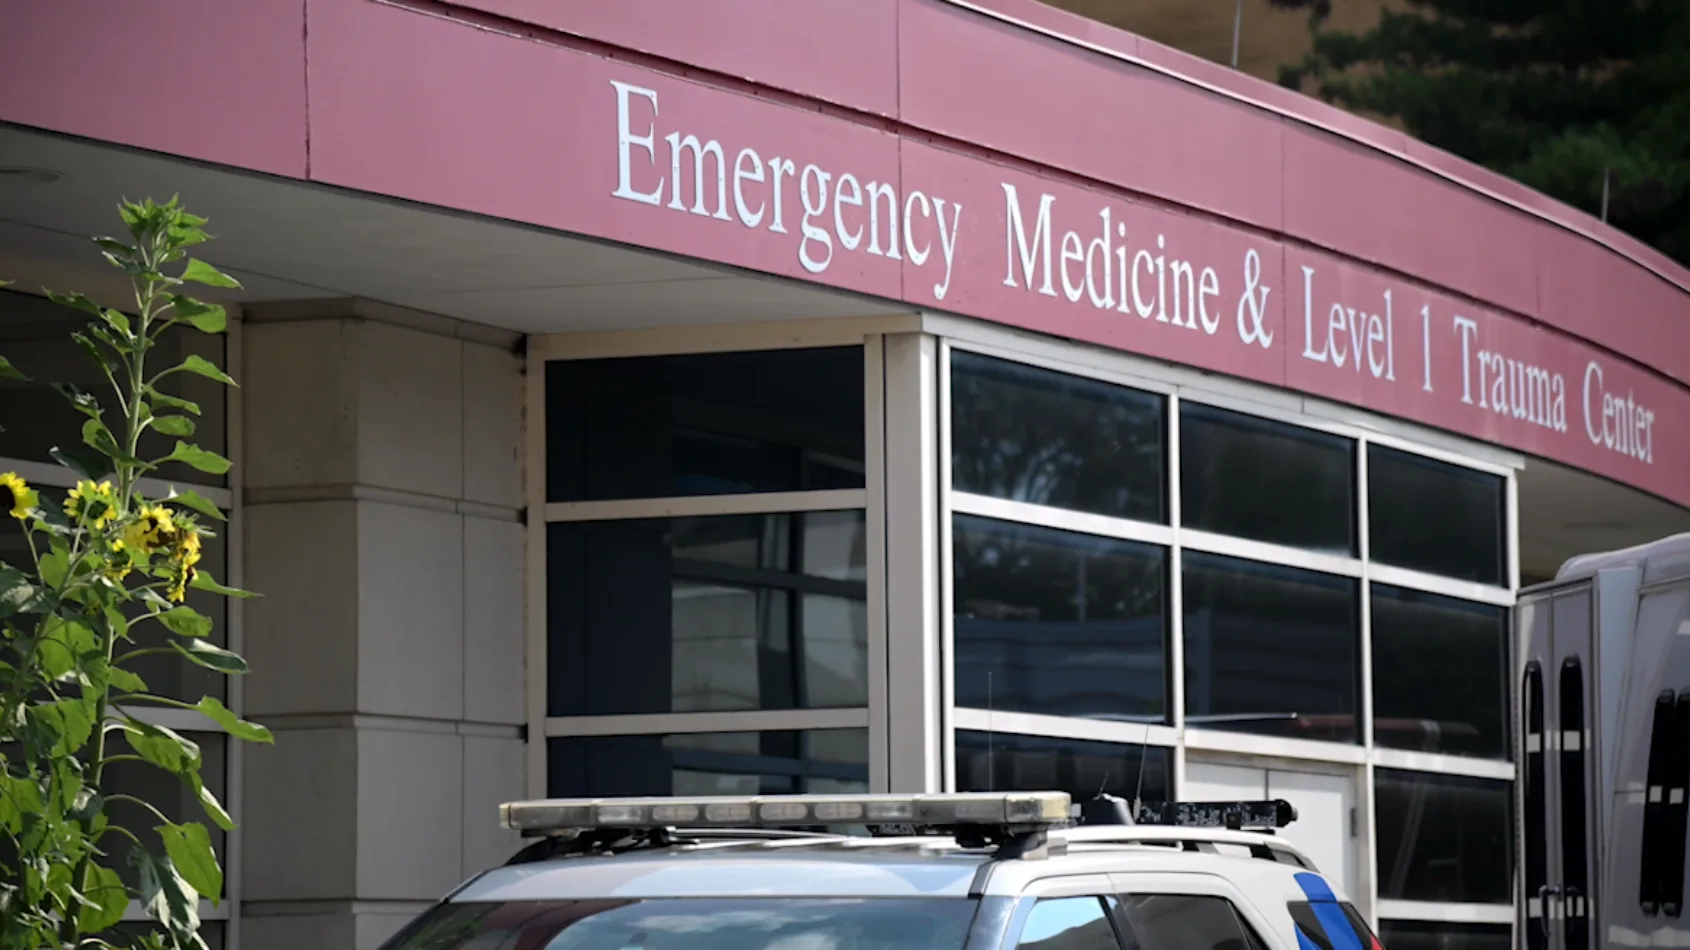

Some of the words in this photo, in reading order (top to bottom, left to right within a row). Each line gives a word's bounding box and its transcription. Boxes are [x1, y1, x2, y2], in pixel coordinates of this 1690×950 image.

[610, 80, 962, 299] Emergency
[1001, 183, 1220, 335] Medicine
[1237, 249, 1273, 348] &
[1301, 266, 1395, 381] Level
[1420, 305, 1433, 392] 1
[1454, 316, 1567, 433] Trauma
[1584, 361, 1655, 464] Center
